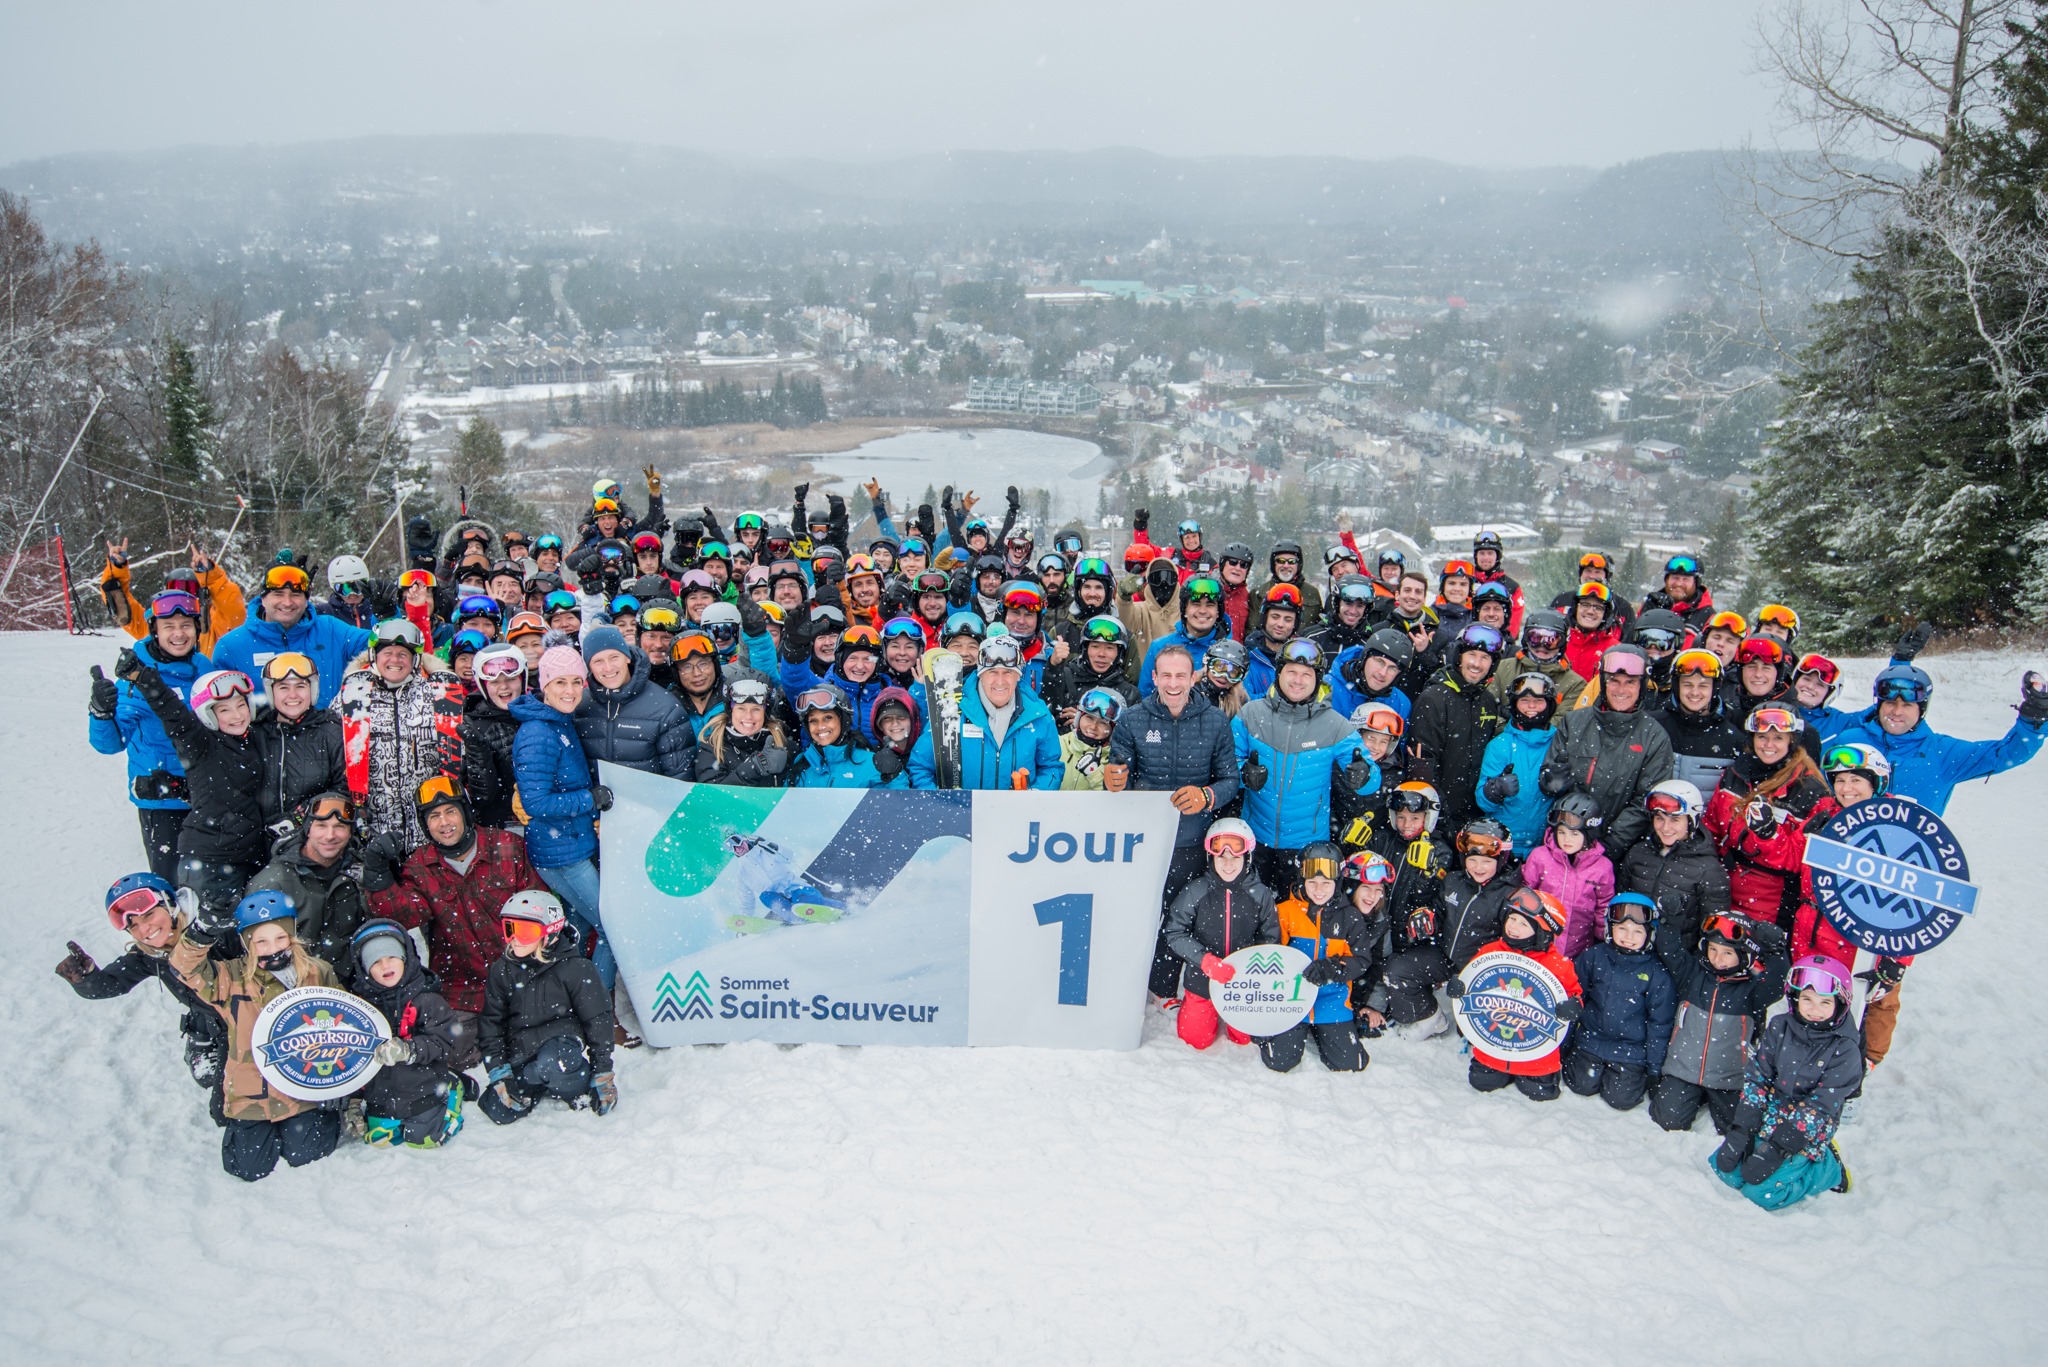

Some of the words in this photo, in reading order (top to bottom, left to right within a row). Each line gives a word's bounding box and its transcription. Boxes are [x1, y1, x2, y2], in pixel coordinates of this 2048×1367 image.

[1007, 821, 1144, 863] Jour
[1833, 803, 1910, 836] SAISON
[1916, 815, 1961, 871] 19-20
[1837, 852, 1918, 892] JOUR
[1935, 881, 1945, 901] 1
[1817, 875, 1955, 952] SAINT-SAUVEUR
[1033, 893, 1094, 1006] 1
[720, 976, 790, 990] Sommet
[1472, 954, 1504, 969] GAGNANT
[1506, 954, 1541, 971] 2018-2019
[1542, 969, 1564, 995] WINNER
[1475, 970, 1497, 988] NATIONAL
[1509, 968, 1528, 978] AREAS
[1528, 976, 1553, 1008] ASSOCIATION
[266, 990, 302, 1014] GAGNANT
[304, 988, 347, 998] 2018-2019
[349, 995, 378, 1015] WINNER
[719, 993, 939, 1022] Saint-Sauveur
[1222, 1005, 1264, 1013] AMÉRIQUE
[1223, 991, 1241, 1002] de
[1245, 991, 1285, 1004] glisse
[1475, 996, 1551, 1027] CONVERSION
[275, 1008, 299, 1032] NATIONAL
[299, 1002, 311, 1010] SKI
[314, 1019, 336, 1028] NSAA
[1490, 1008, 1531, 1032] Cup
[280, 1032, 371, 1052] CONVERSION
[301, 1042, 350, 1063] Cup
[282, 1063, 306, 1082] CREATING
[306, 1077, 334, 1085] LIFELONG
[335, 1056, 368, 1082] ENTHUSIASTS
